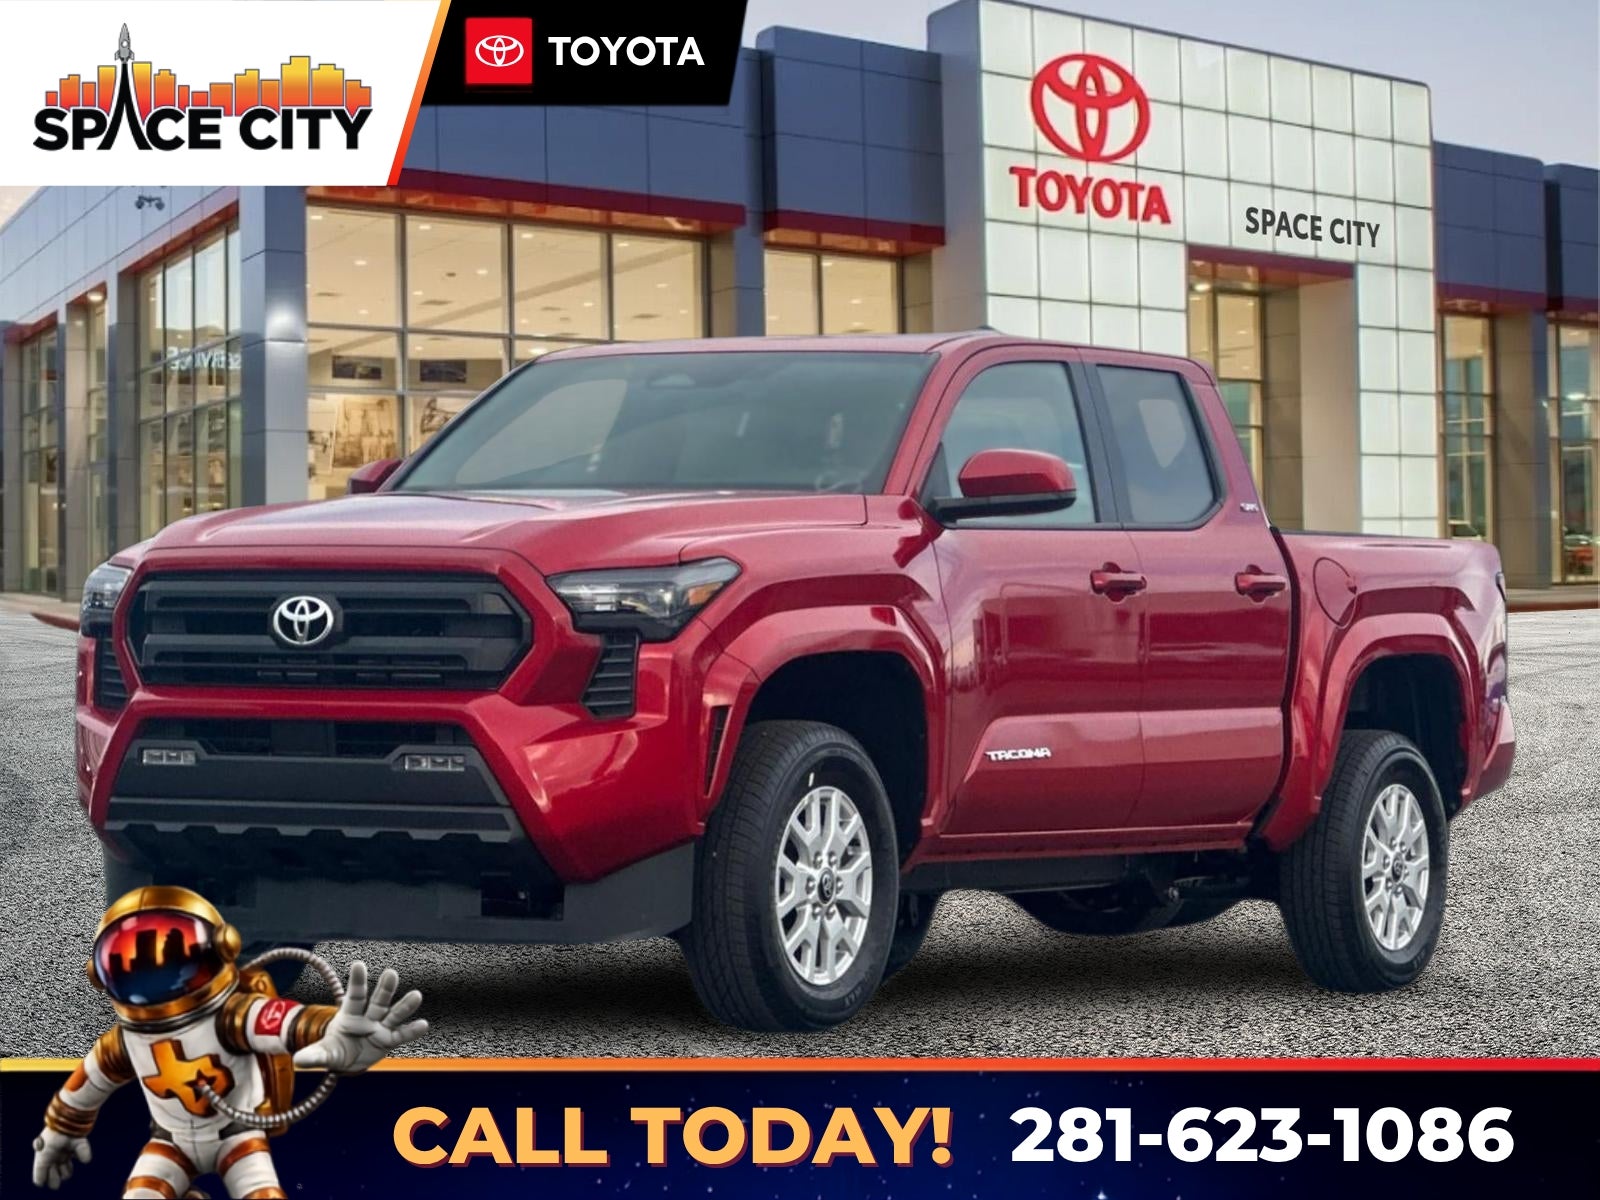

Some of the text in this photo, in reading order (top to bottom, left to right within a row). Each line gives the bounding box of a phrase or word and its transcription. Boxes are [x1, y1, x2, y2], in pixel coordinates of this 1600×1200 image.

[1009, 166, 1171, 225] TOYOTA
[1245, 206, 1381, 249] SPACE CITY
[985, 747, 1051, 761] TACOMA
